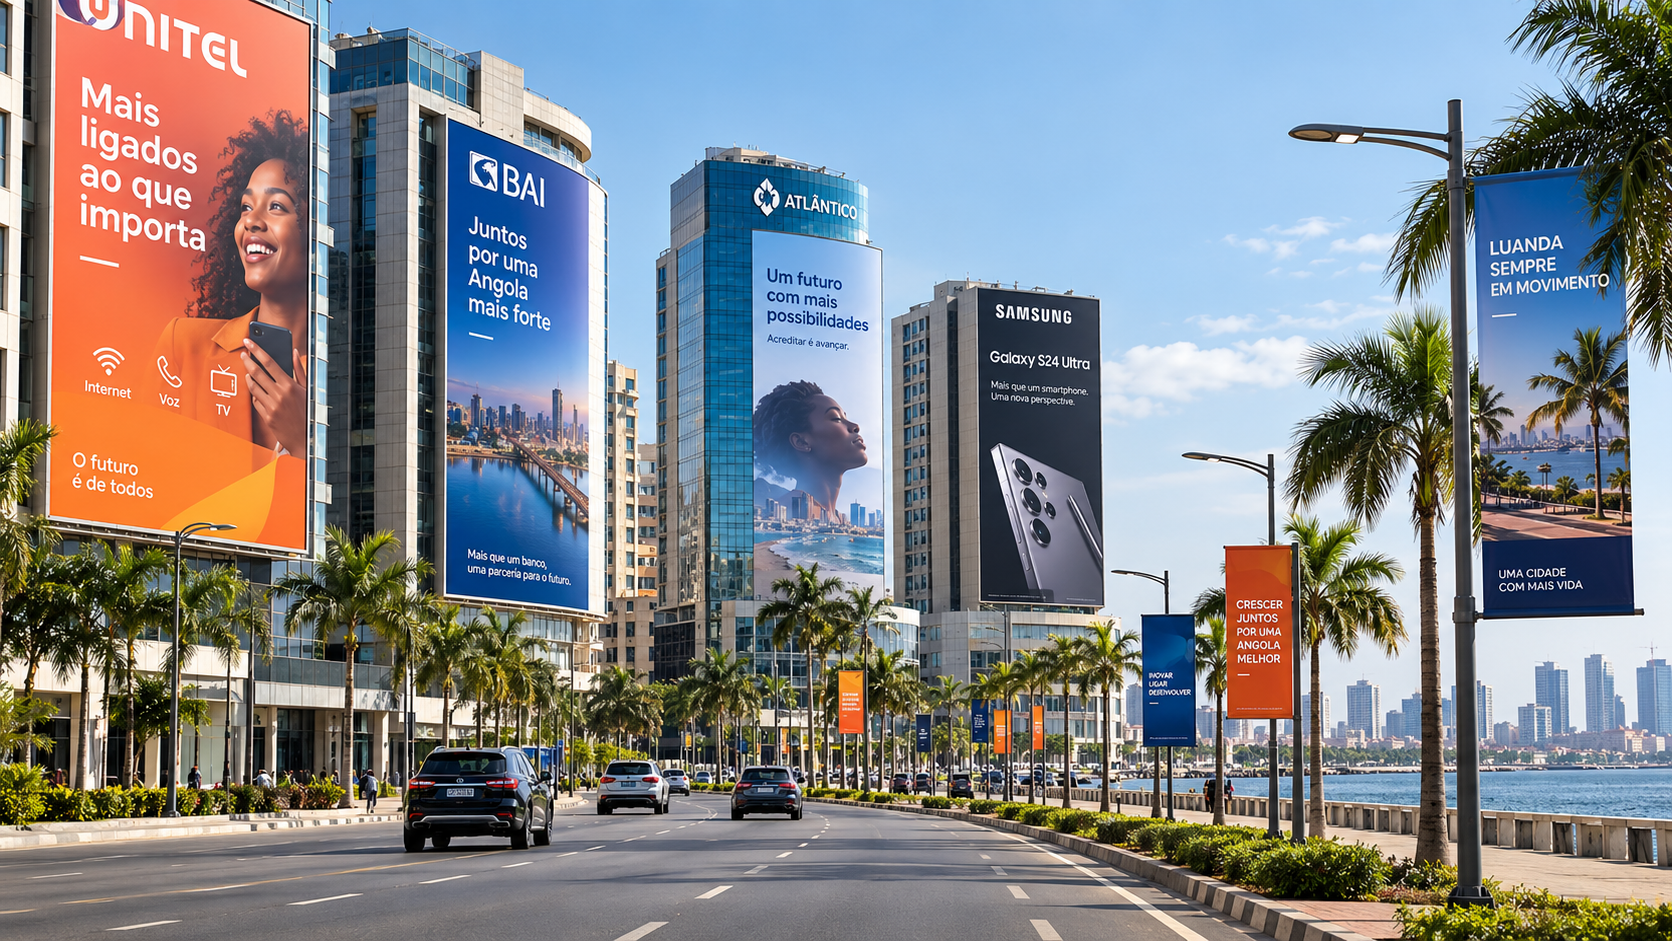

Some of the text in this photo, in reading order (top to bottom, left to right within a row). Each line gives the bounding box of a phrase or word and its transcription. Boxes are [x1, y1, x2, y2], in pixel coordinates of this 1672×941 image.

[79, 0, 247, 78] UNITEL
[81, 76, 160, 127] Mais
[81, 115, 198, 174] ligados
[80, 162, 192, 209] ao que
[503, 162, 545, 208] BAI
[784, 193, 858, 220] ATLÂNTICO
[80, 193, 206, 251] importa
[468, 216, 527, 250] Juntos
[1490, 234, 1564, 256] LUANDA
[469, 244, 538, 279] por uma
[1490, 256, 1557, 277] SEMPRE
[468, 268, 528, 300] Angola
[766, 267, 843, 291] Um futuro
[1491, 273, 1610, 297] EM MOVIMENTO
[766, 290, 838, 309] com mais
[469, 297, 551, 331] mais forte
[766, 309, 869, 332] possibilidades
[995, 303, 1072, 325] SAMSUNG
[766, 333, 850, 352] Acreditar é avançar.
[989, 350, 1091, 370] Galaxy S24 Ultra
[84, 380, 132, 400] Internet
[991, 380, 1010, 390] Mais
[1011, 383, 1026, 392] que
[1041, 385, 1089, 396] smartphone.
[991, 392, 1009, 401] Uma
[159, 393, 180, 408] Voz
[215, 403, 231, 417] TV
[72, 452, 138, 476] O futuro
[72, 473, 154, 499] é de todos
[467, 548, 548, 571] Mais que um banco,
[467, 565, 486, 575] uma
[522, 571, 541, 581] para
[541, 574, 547, 582] o
[548, 572, 572, 586] futuro.
[1498, 567, 1567, 579] UMA CIDADE
[1498, 580, 1583, 592] COM MAIS VIDA
[1236, 599, 1283, 610] CRESCER
[1236, 613, 1278, 624] JUNTOS
[1236, 627, 1282, 637] POR UMA
[1236, 640, 1281, 650] ANGOLA
[1237, 653, 1281, 664] MELHOR
